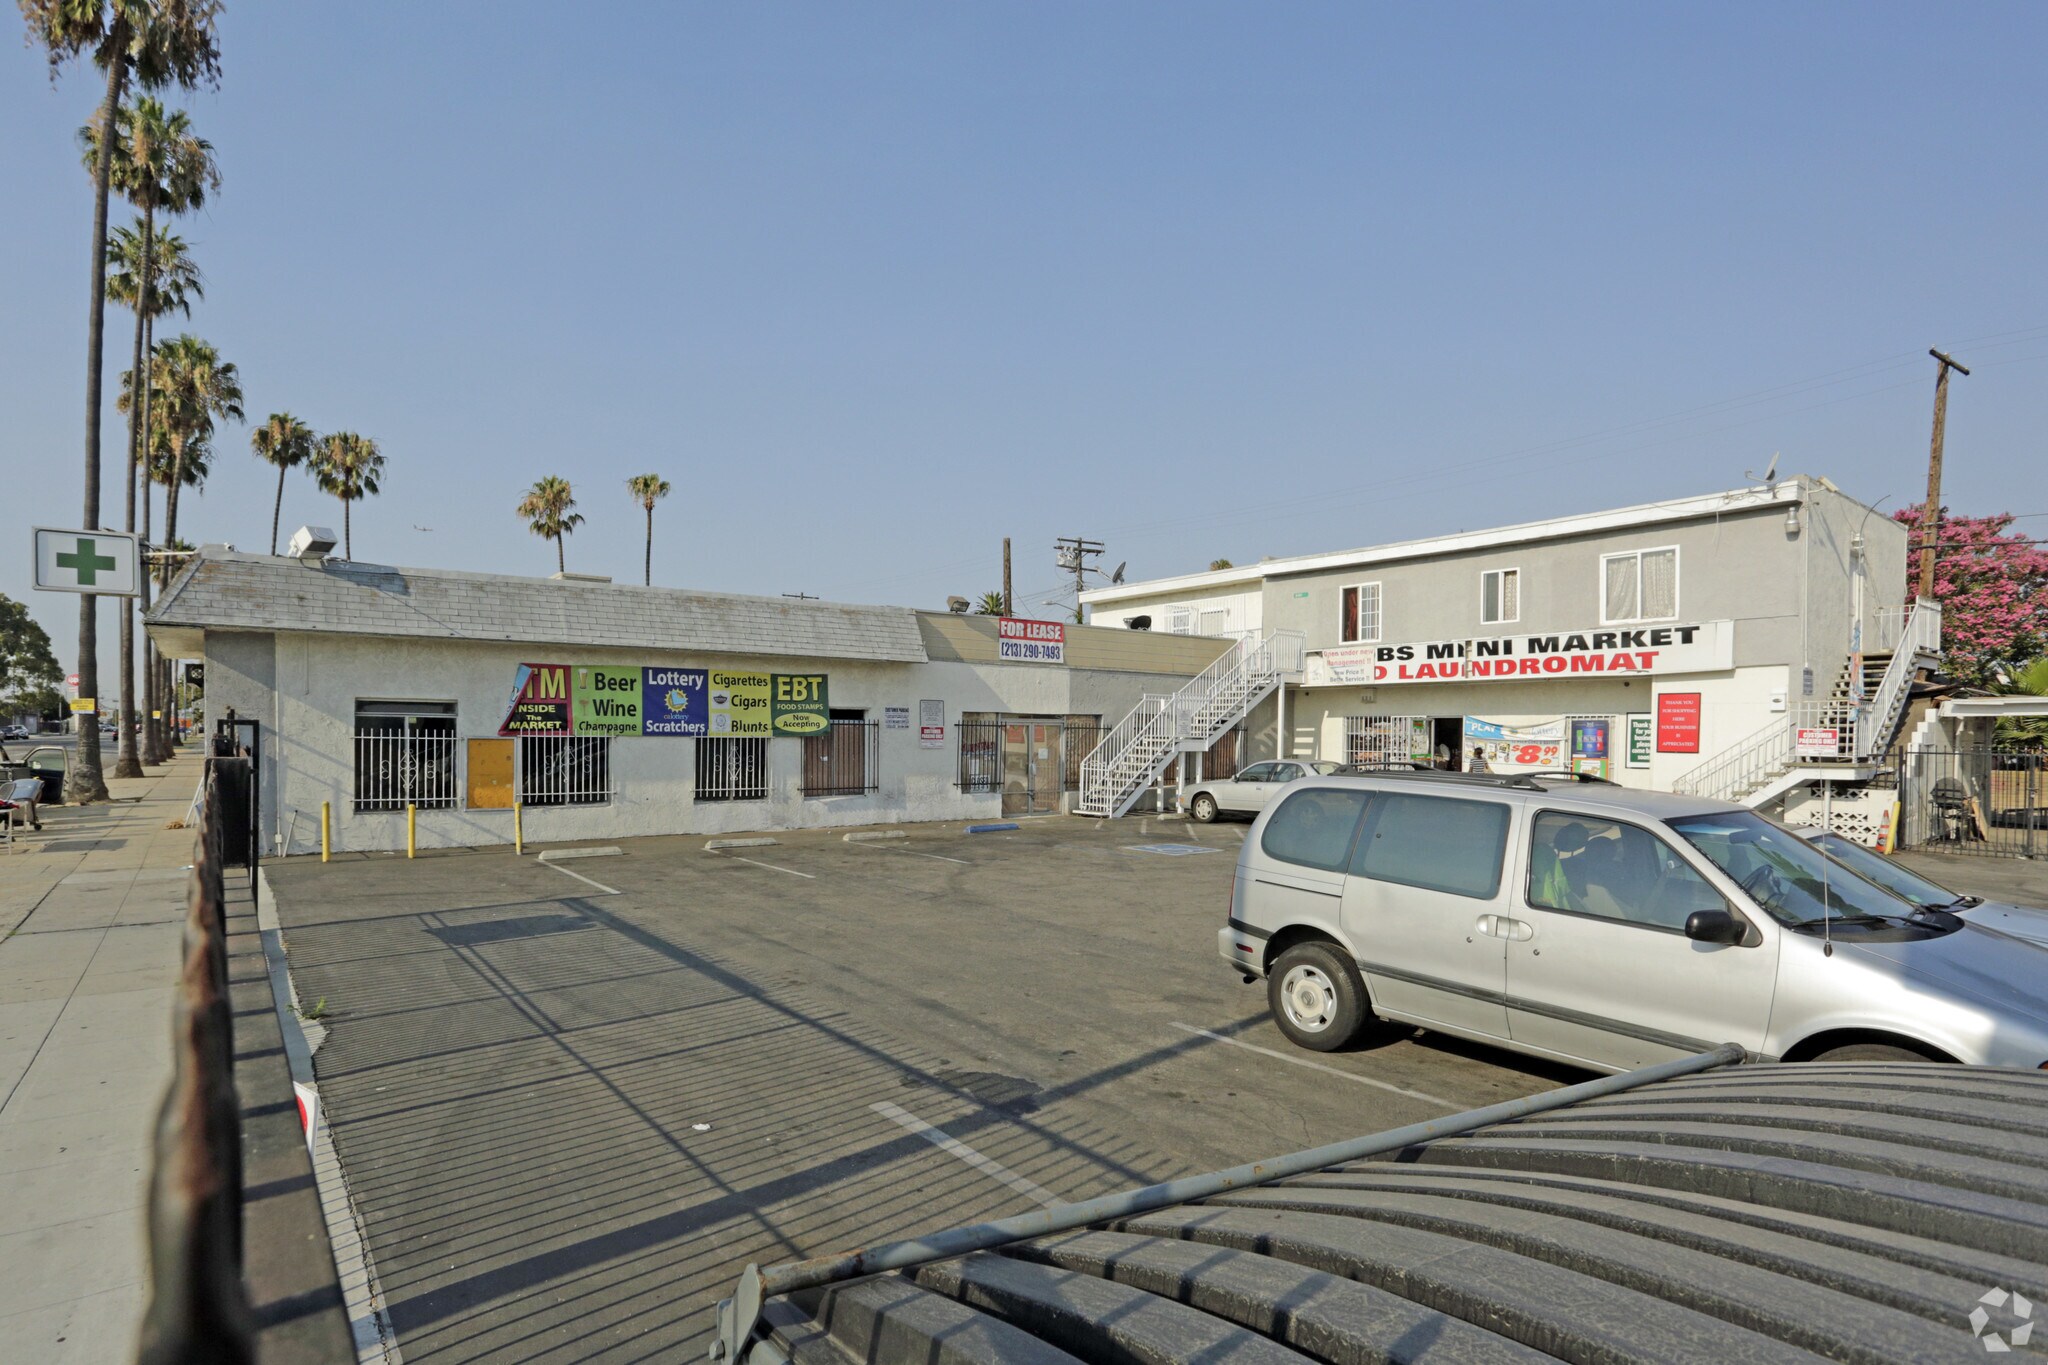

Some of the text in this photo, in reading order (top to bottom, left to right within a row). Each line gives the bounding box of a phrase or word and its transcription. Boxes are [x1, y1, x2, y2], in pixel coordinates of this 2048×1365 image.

[1000, 620, 1061, 640] FOR LEASE
[1528, 626, 1700, 654] MARKET
[1001, 642, 1060, 660] (213) 290-7493
[1398, 651, 1659, 680] LAUNDROMAT
[594, 672, 637, 692] Beer
[648, 670, 704, 690] Lottery
[713, 673, 768, 688] Cigarettes
[776, 676, 823, 701] EBT
[592, 699, 637, 717] Wine
[731, 694, 768, 710] Cigars
[508, 721, 562, 730] MARKET
[578, 721, 638, 734] Champagne
[646, 720, 706, 733] Scratchers
[731, 720, 768, 733] Blunts
[782, 720, 821, 729] Accepting
[1471, 722, 1495, 732] PLAY
